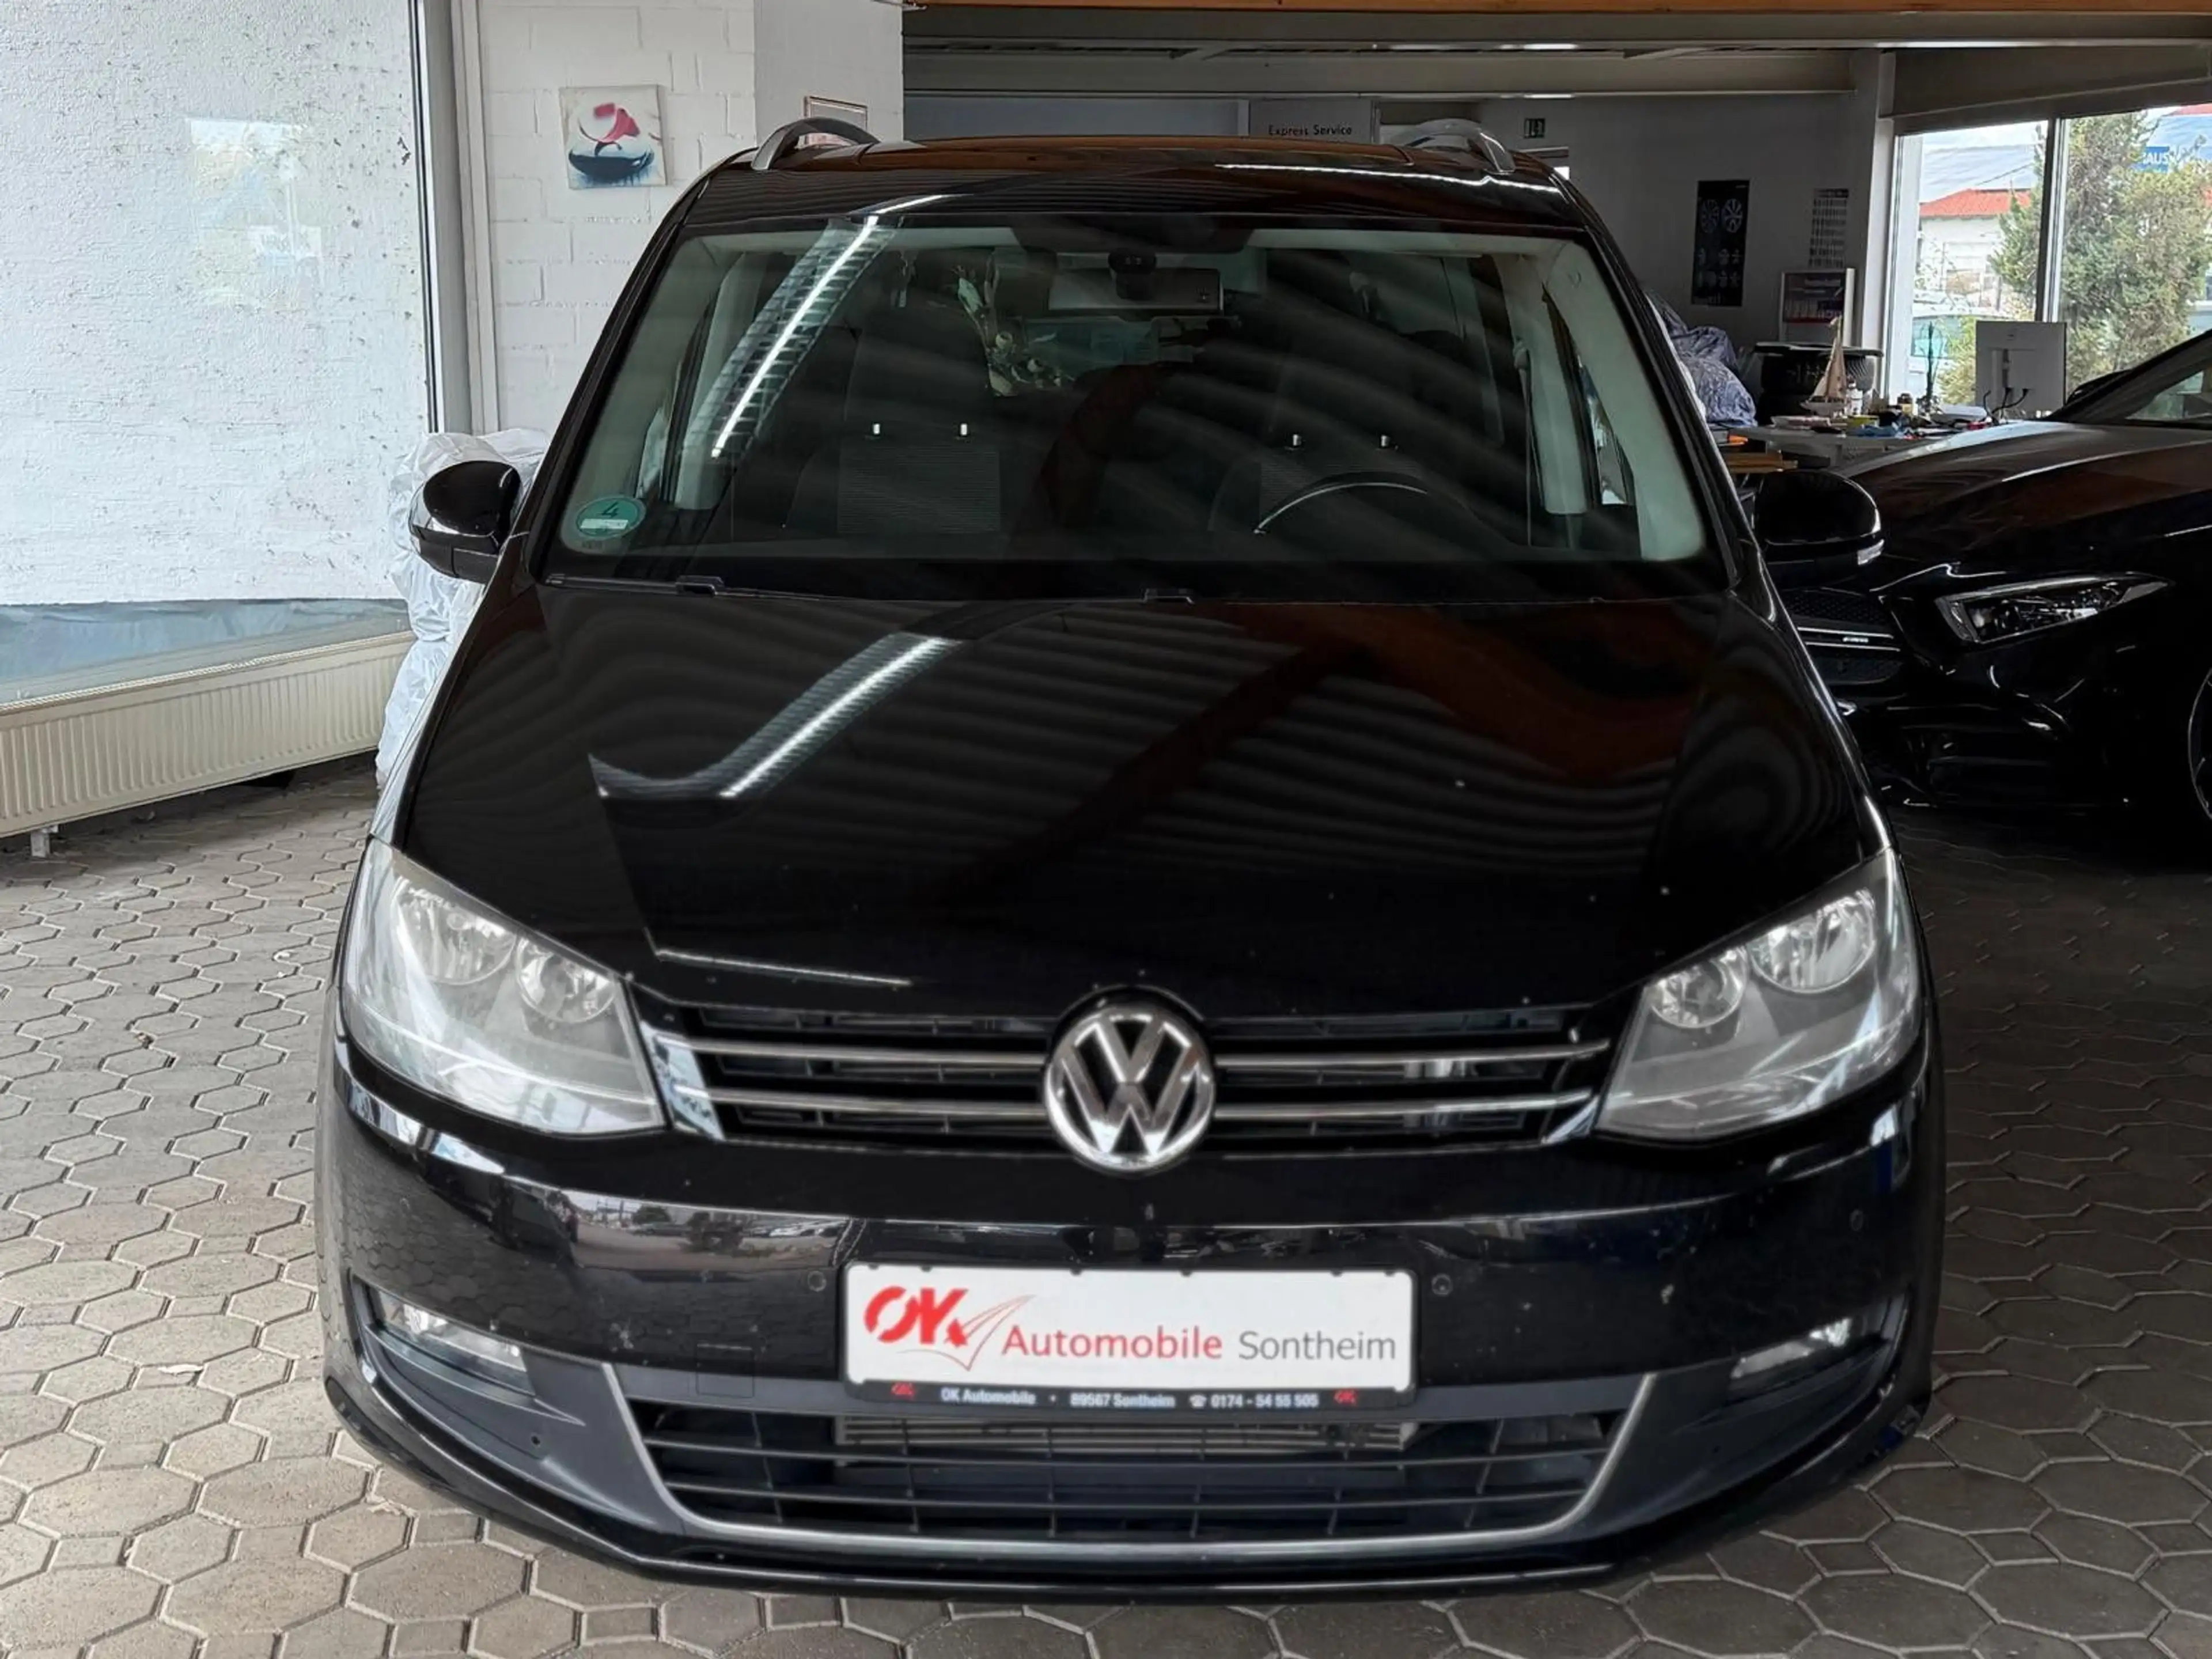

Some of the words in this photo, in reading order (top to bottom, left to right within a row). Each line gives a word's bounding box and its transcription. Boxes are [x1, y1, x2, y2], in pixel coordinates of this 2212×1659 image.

[1313, 123, 1353, 136] Service
[601, 501, 619, 518] 4
[864, 1285, 969, 1348] OK
[1001, 1324, 1223, 1359] Automobile
[1238, 1330, 1396, 1361] Sontheim
[941, 1387, 960, 1402] OK
[963, 1388, 1036, 1404] Automobile
[1113, 1392, 1176, 1408] Sontheim
